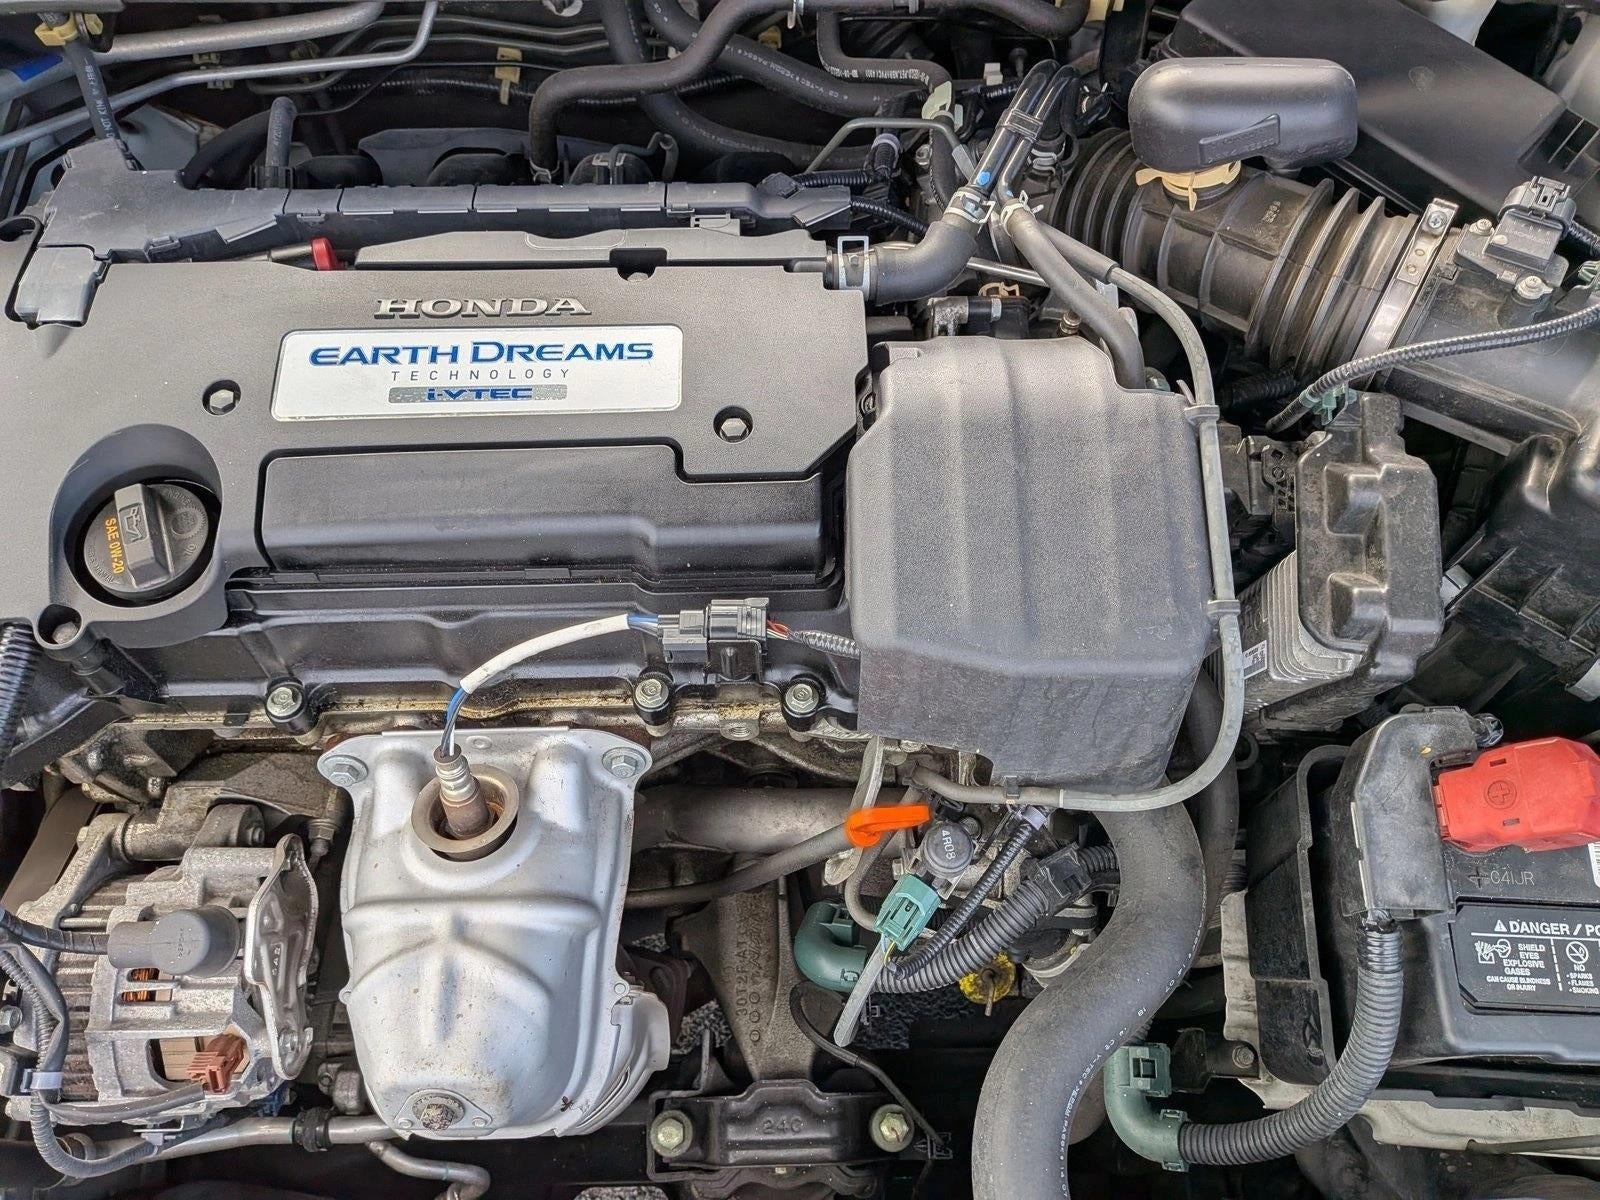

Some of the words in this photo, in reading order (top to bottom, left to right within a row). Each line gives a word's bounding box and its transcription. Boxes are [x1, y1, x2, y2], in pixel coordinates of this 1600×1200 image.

[374, 298, 592, 319] HONDA
[309, 345, 459, 367] EARTH
[470, 340, 653, 365] DREAMS
[391, 368, 571, 382] TECHNOLOGY
[425, 388, 533, 401] i-VTEC
[105, 517, 120, 541] SAE
[109, 541, 125, 575] 0W-20
[941, 829, 957, 861] 4R08
[1509, 920, 1571, 936] DANGER
[1517, 943, 1546, 952] SHIELD
[1519, 951, 1541, 960] EYES
[1502, 958, 1546, 969] EXPLOSIVE
[1573, 964, 1586, 972] NO
[1504, 967, 1531, 976] GASES
[1486, 975, 1499, 983] CAN
[1500, 976, 1519, 984] CAUSE
